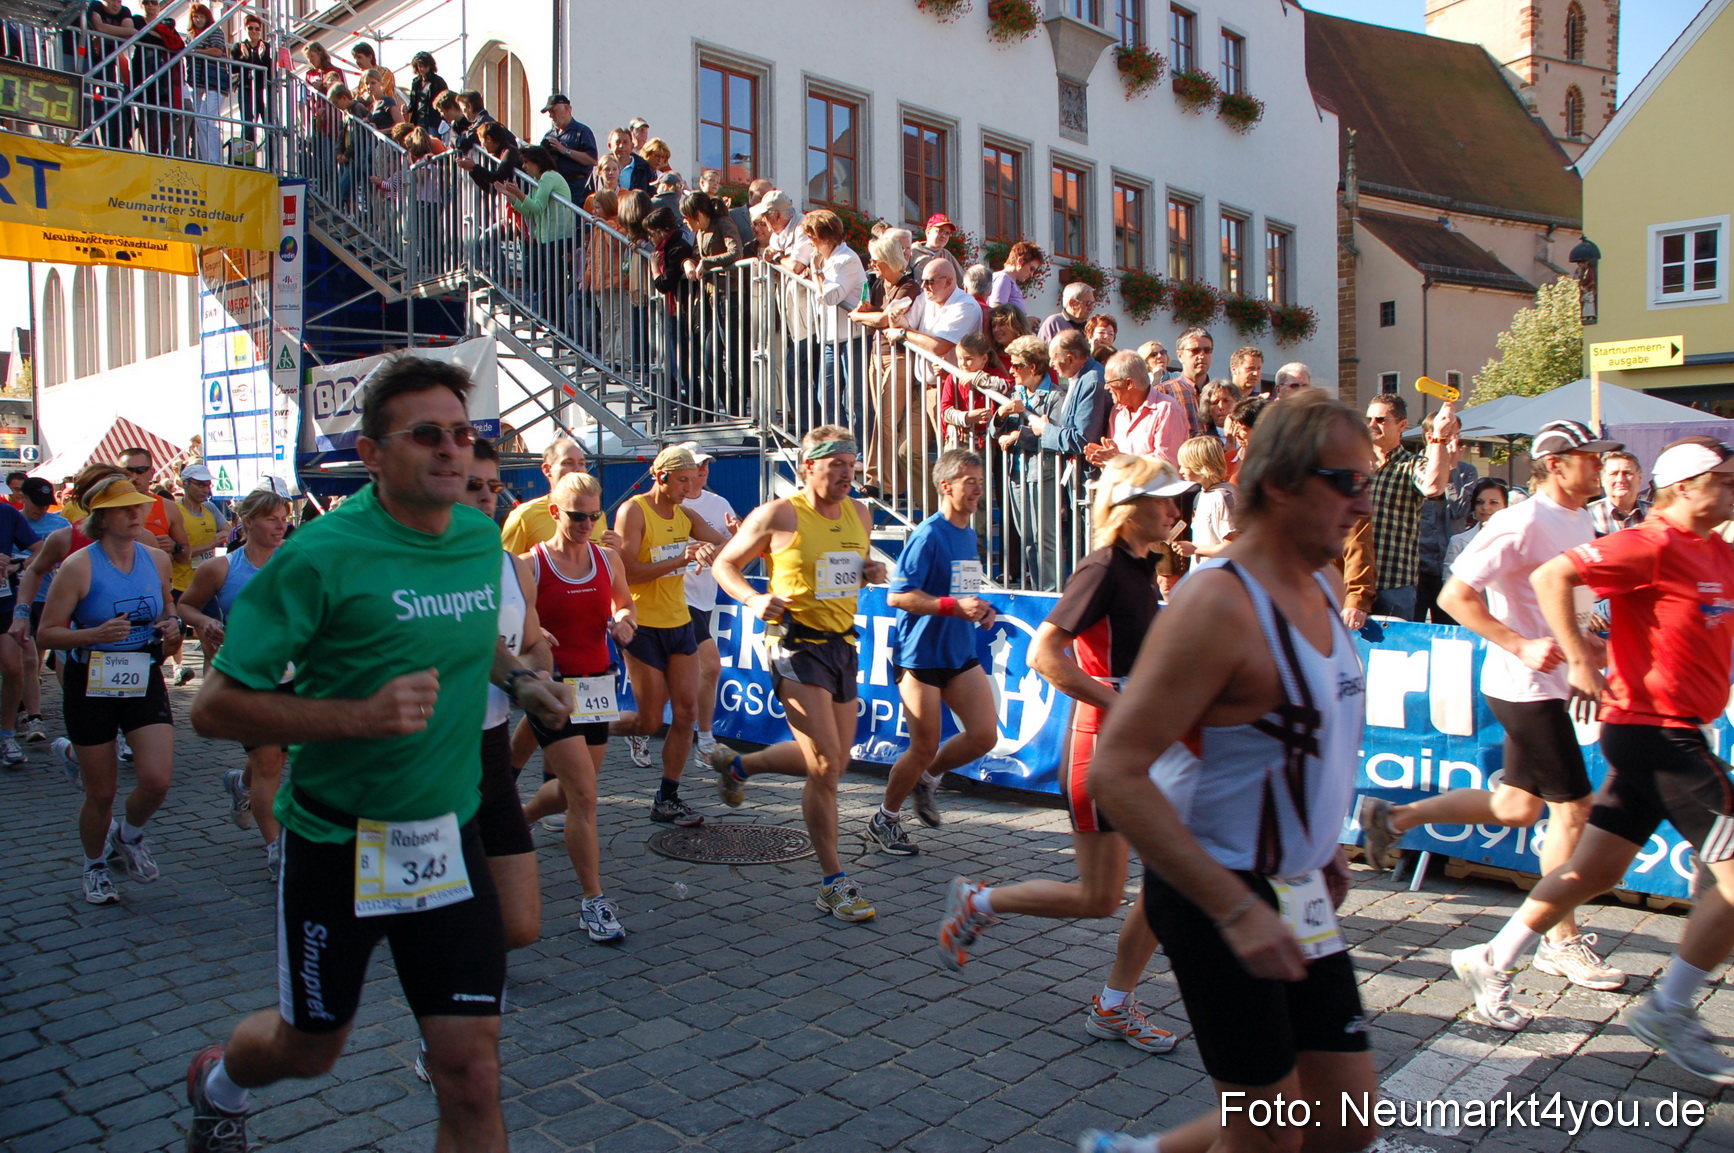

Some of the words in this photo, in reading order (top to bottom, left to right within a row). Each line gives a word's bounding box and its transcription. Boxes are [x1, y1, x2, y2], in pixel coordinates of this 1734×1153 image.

[108, 196, 186, 216] Neumarkter
[189, 206, 245, 223] Stadtlauf
[1593, 343, 1666, 356] Startnummern-
[1608, 355, 1650, 367] ausgabe
[834, 571, 857, 585] 808
[391, 582, 497, 622] Sinupret
[105, 656, 129, 667] Sylvia
[111, 672, 140, 685] 420
[578, 682, 590, 691] Pia
[585, 696, 610, 709] 419
[390, 827, 440, 848] Robert
[300, 919, 337, 1021] Sinupret
